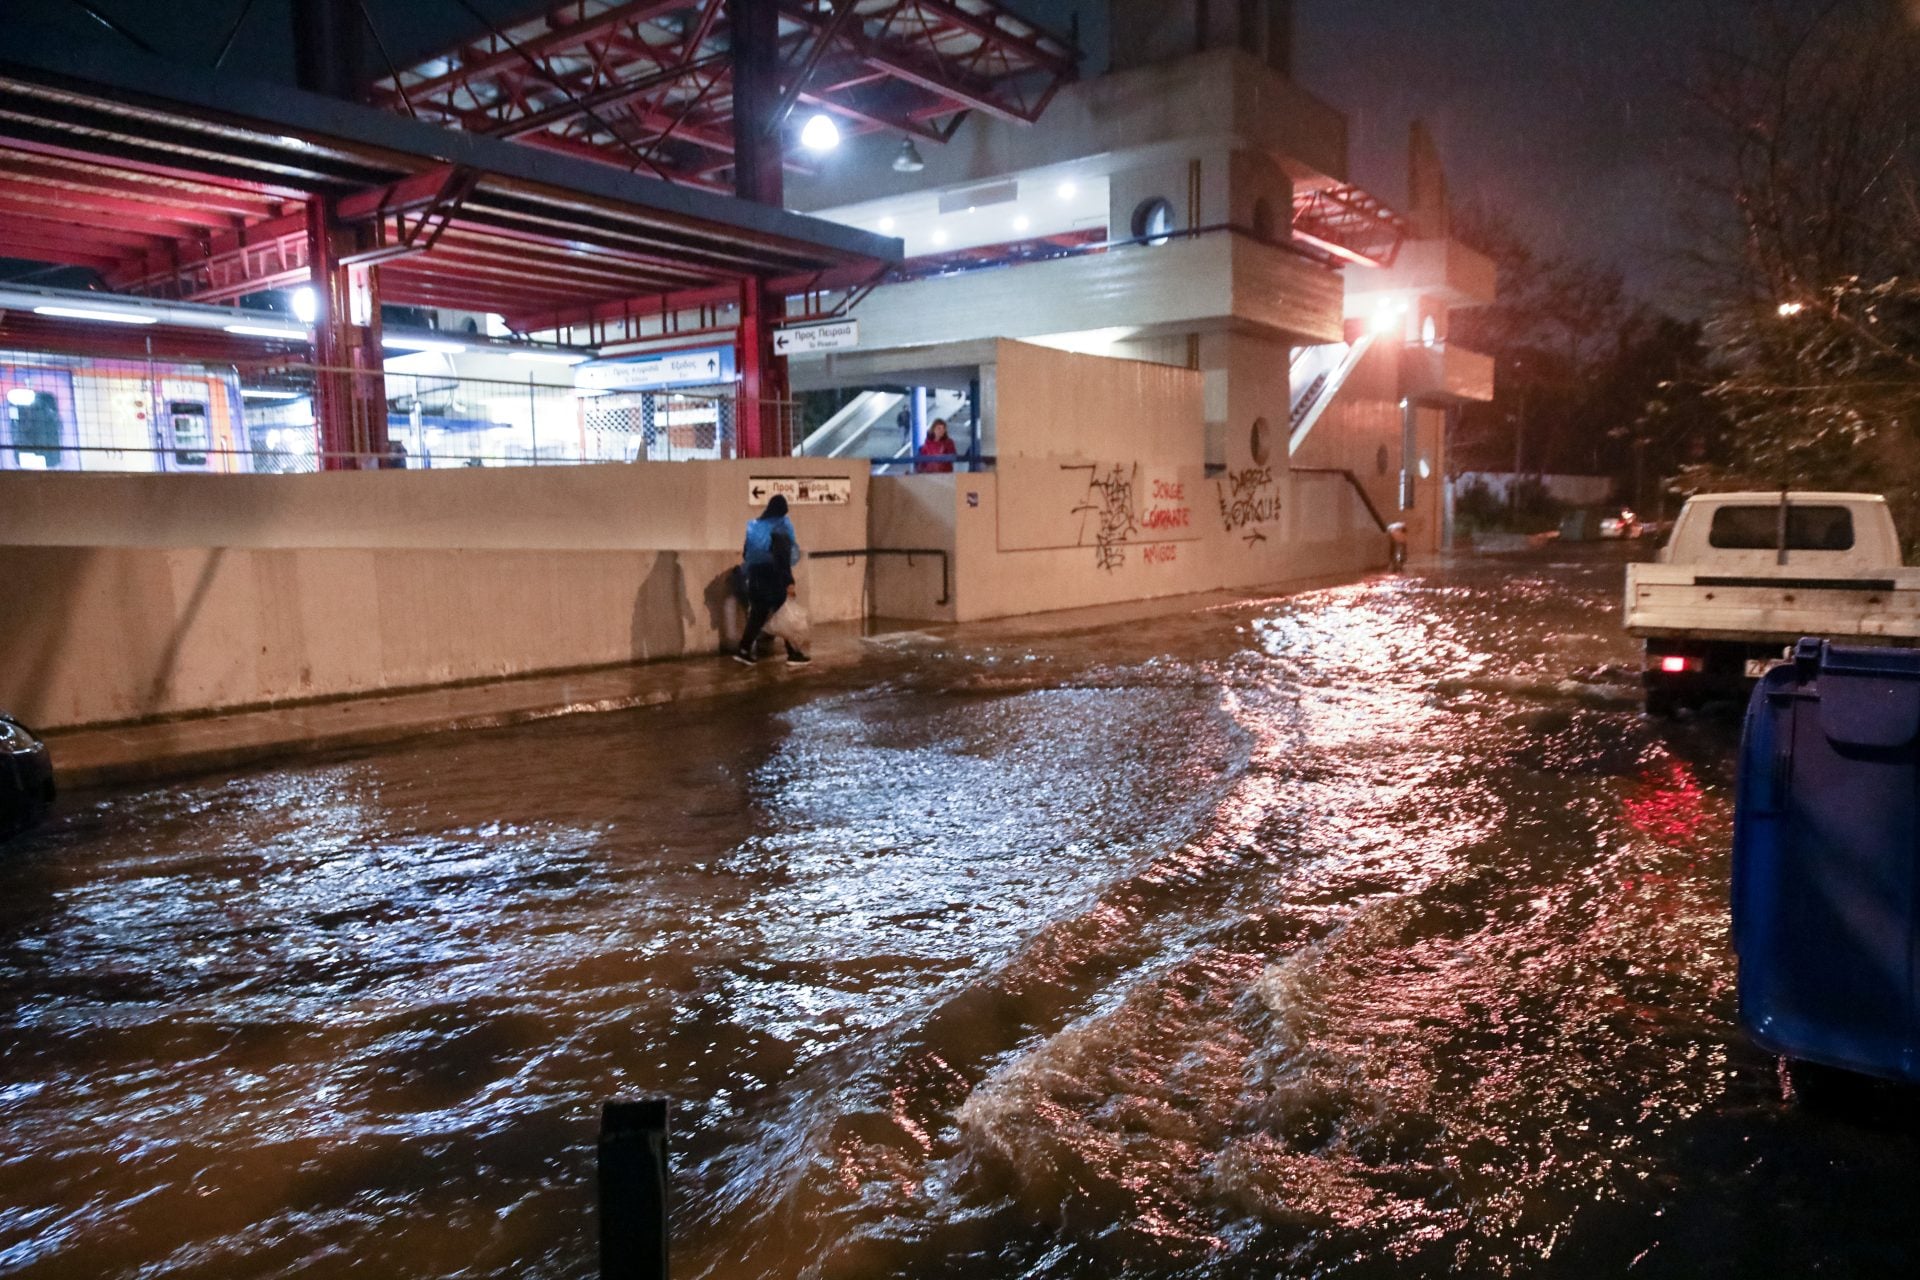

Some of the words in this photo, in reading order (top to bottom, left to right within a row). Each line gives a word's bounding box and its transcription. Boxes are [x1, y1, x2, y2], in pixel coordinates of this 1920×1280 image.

[795, 330, 816, 341] Προς
[818, 326, 851, 338] Πειραιά
[773, 482, 795, 494] Προς
